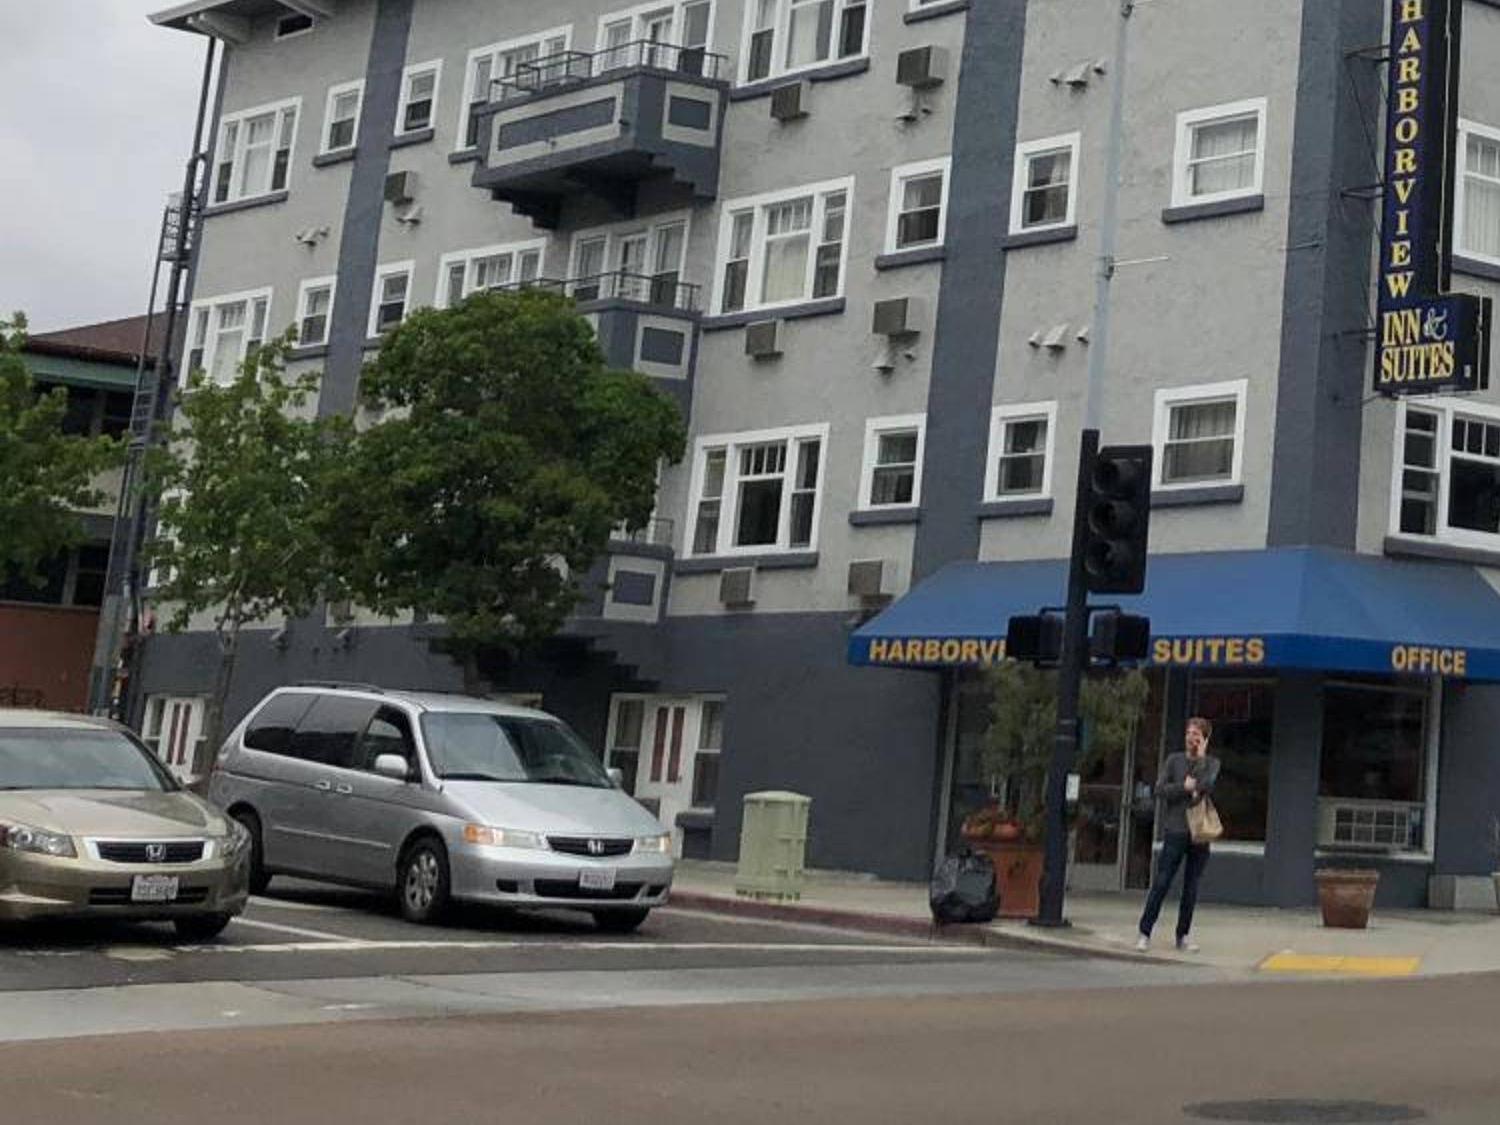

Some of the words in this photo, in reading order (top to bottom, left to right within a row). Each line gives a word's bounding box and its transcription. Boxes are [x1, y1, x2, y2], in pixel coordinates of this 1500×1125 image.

[1382, 308, 1422, 347] INN
[1423, 307, 1448, 341] &
[1380, 340, 1455, 383] SUITES
[868, 638, 1007, 665] HARBORVI
[1152, 638, 1265, 664] SUITES
[1391, 644, 1466, 674] OFFICE
